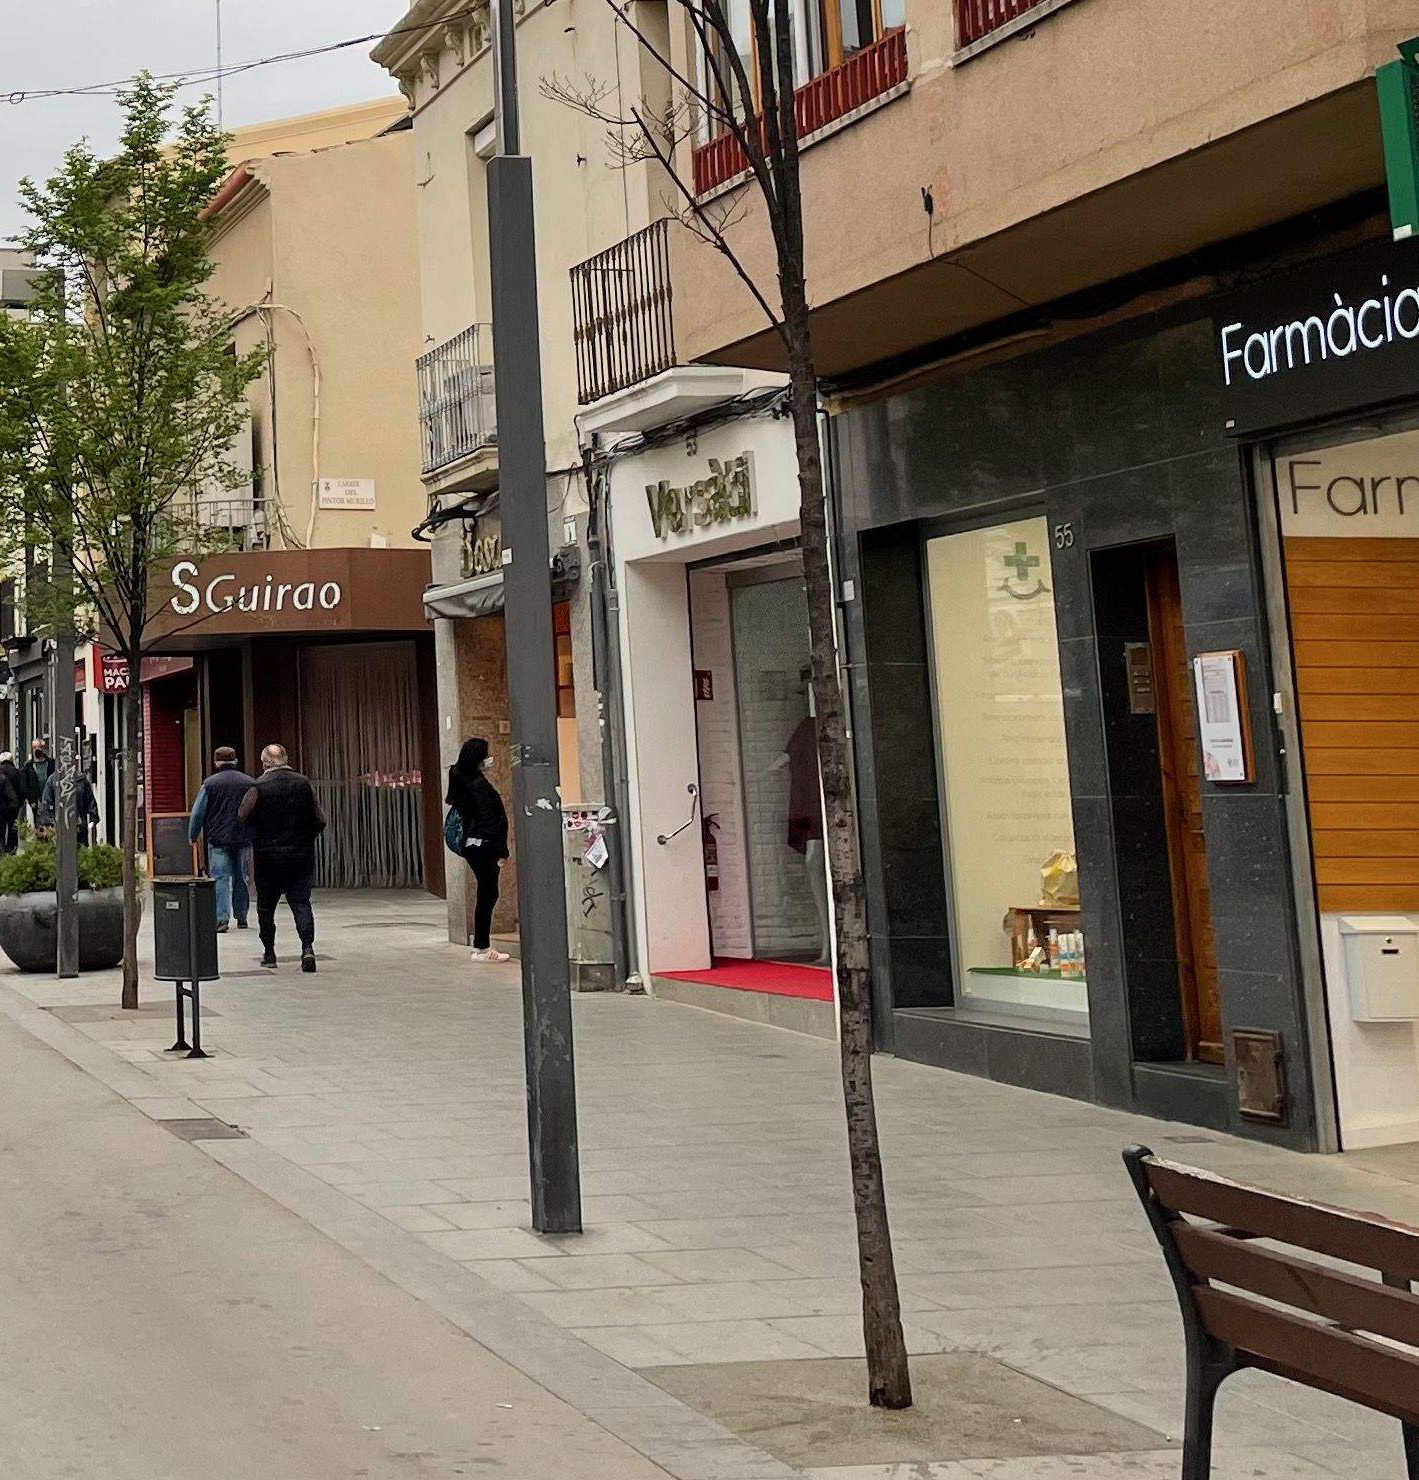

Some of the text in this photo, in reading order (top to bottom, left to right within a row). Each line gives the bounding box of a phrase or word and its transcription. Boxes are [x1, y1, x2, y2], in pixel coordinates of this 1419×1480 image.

[1221, 274, 1419, 386] Farmàcia
[1054, 523, 1074, 549] 55
[103, 667, 129, 677] MAC
